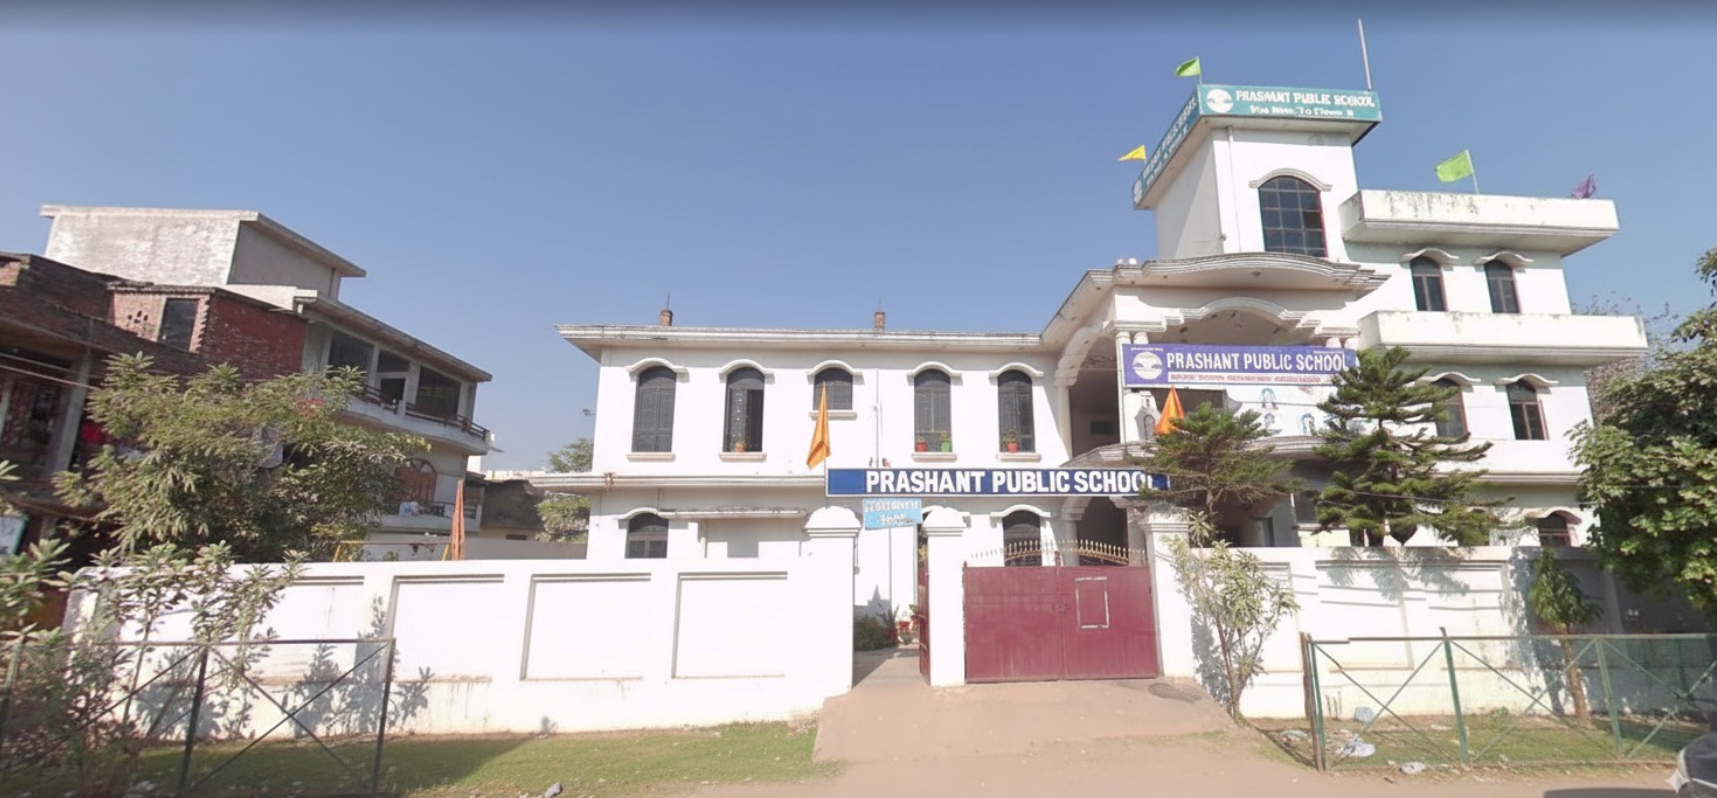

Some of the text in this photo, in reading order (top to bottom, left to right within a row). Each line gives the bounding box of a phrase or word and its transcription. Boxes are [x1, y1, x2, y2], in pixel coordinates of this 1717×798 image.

[1166, 352, 1349, 372] PRASHANT PUBLIC SCHOOL
[866, 470, 1159, 493] PRASHANT PUBLIC SCHOOL
